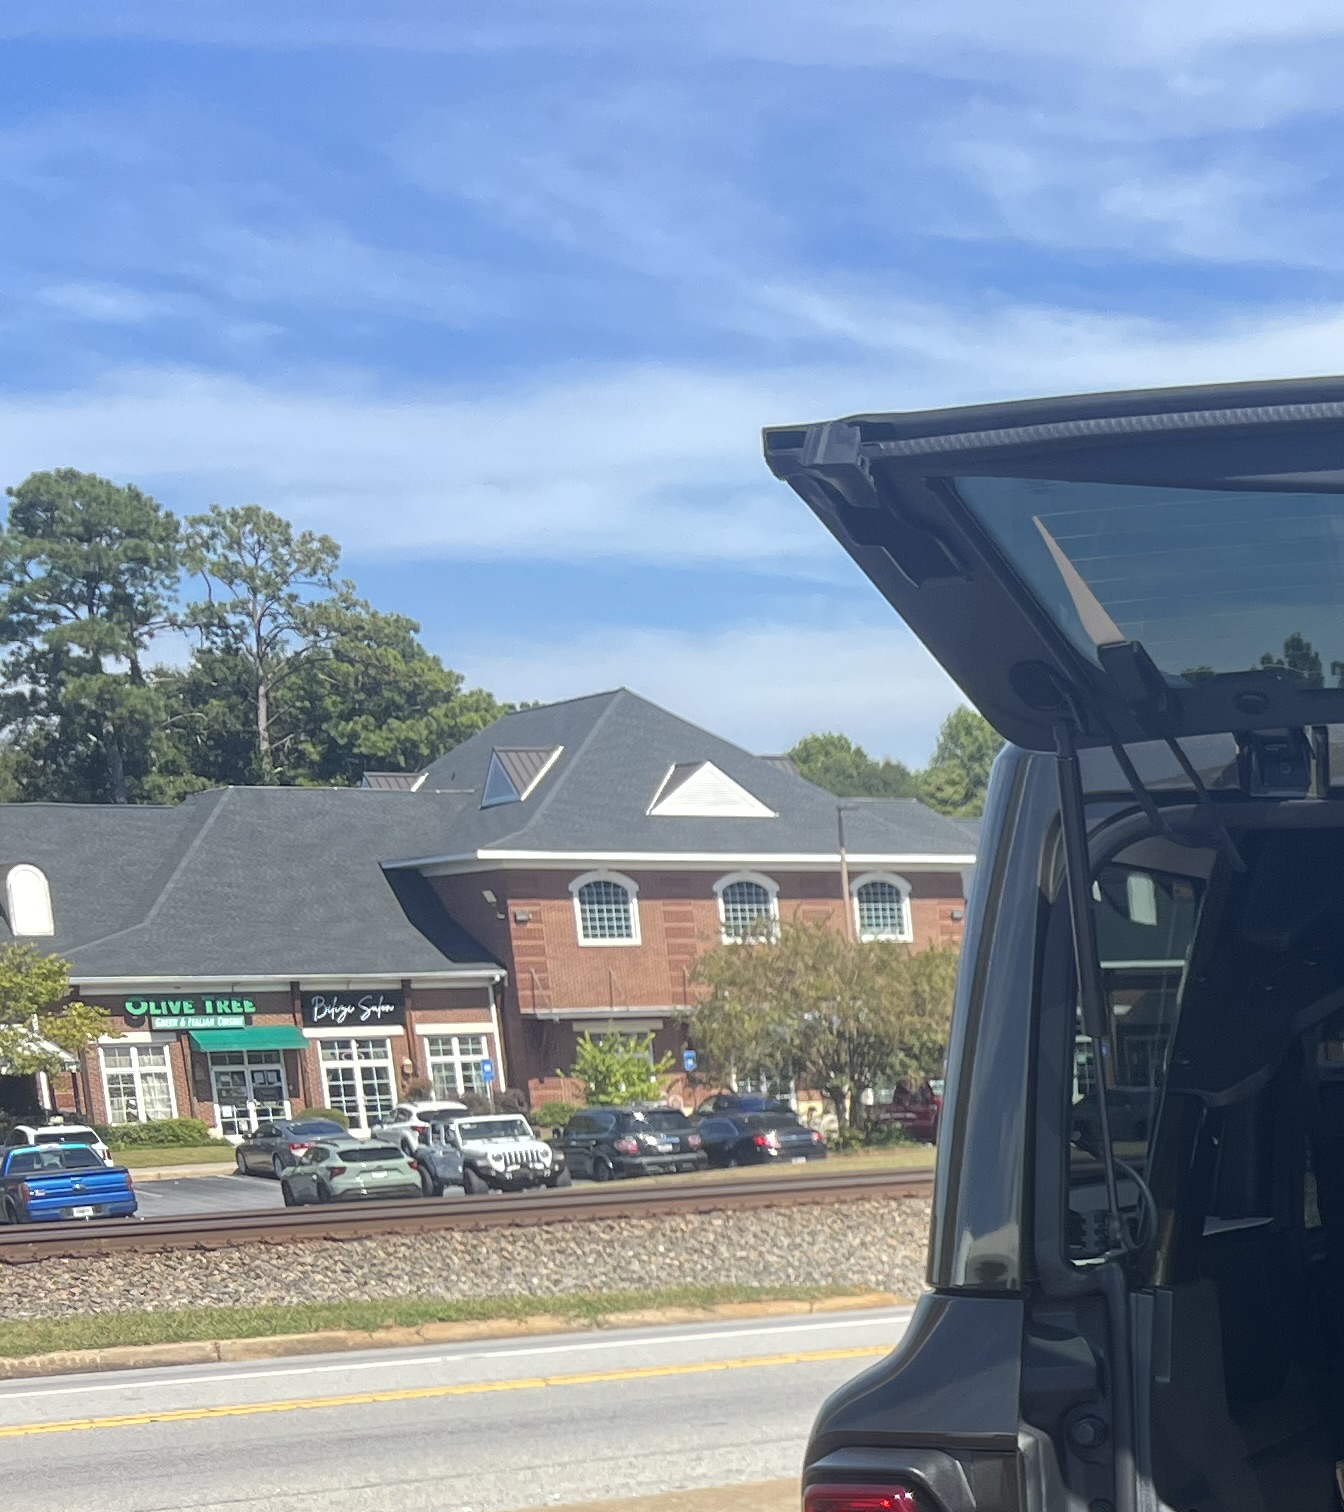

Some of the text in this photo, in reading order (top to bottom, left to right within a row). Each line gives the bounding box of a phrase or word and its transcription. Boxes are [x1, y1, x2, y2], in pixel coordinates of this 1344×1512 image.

[125, 994, 257, 1016] OLIVE TREE
[357, 995, 395, 1022] Salon
